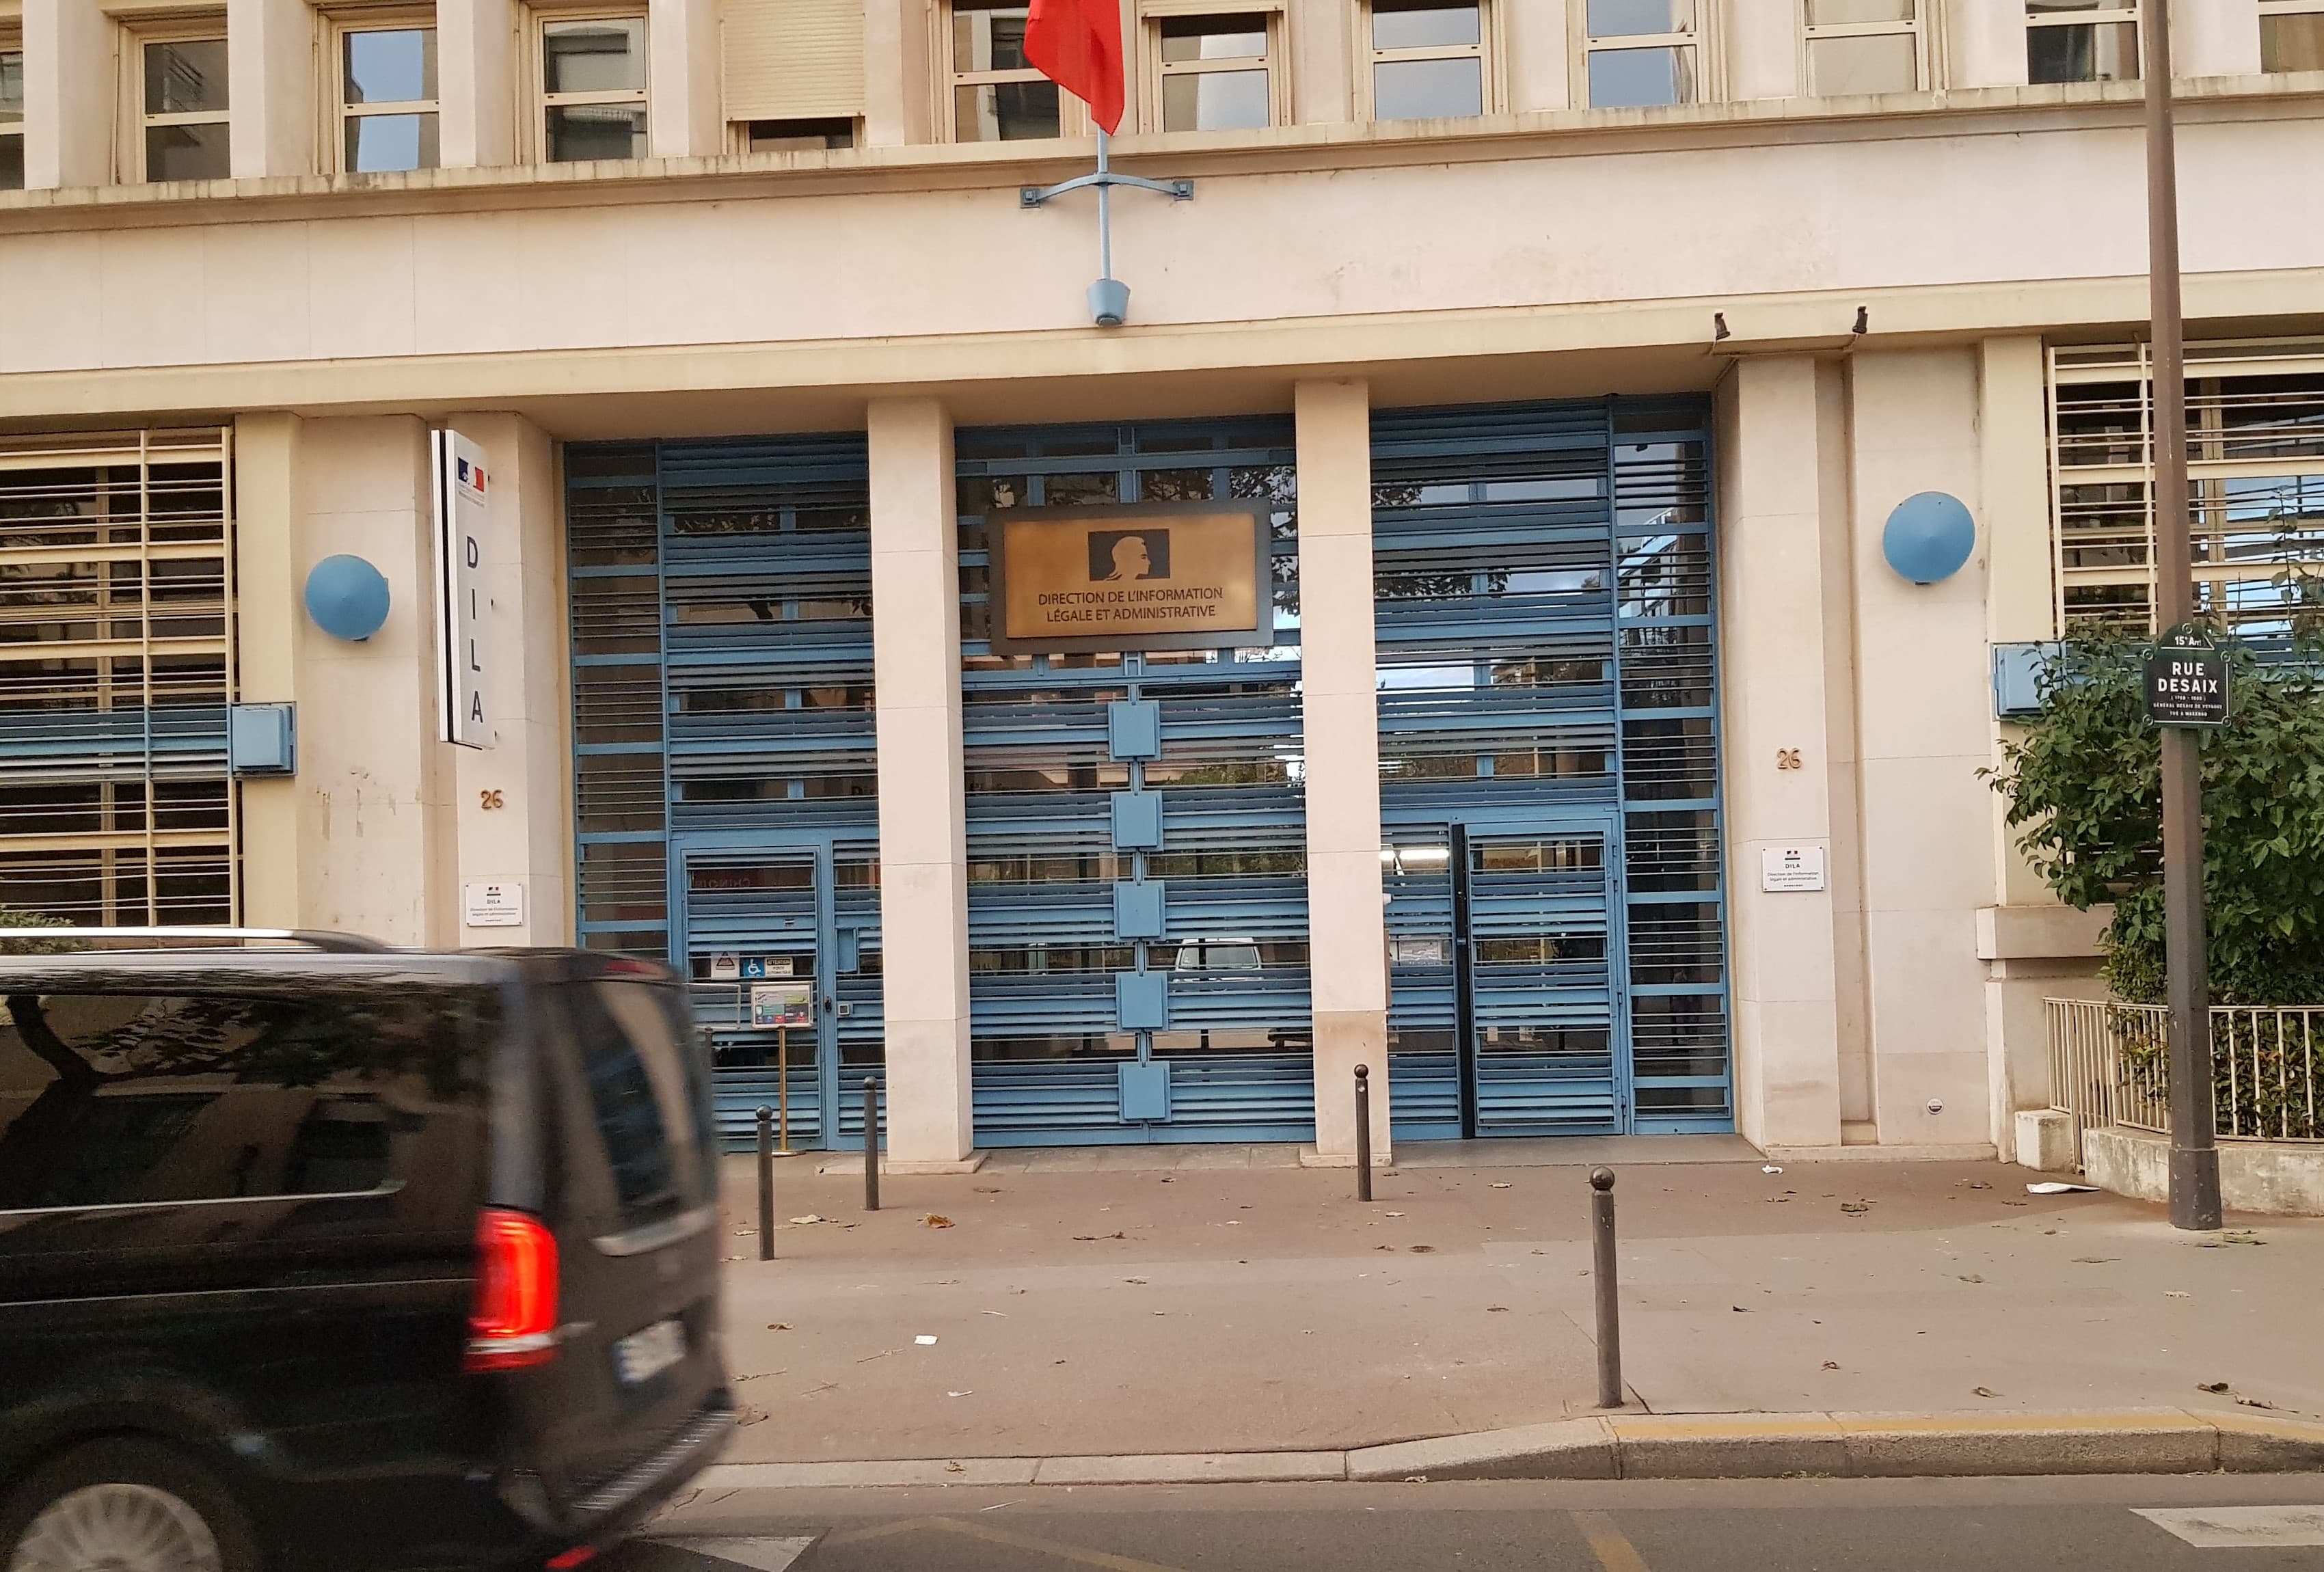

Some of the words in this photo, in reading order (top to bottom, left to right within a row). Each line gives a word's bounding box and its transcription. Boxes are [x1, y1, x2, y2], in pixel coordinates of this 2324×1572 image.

[1038, 592, 1105, 606] DIRECTION
[1108, 591, 1124, 603] DE
[1128, 587, 1223, 602] L'INFORMATION
[1046, 608, 1093, 622] LÉGALE
[1096, 609, 1111, 621] ET
[1113, 605, 1216, 620] ADMINISTRATIVE
[466, 536, 483, 723] DILA
[2172, 662, 2205, 676] RUE
[2158, 678, 2217, 694] DESAIX
[1777, 748, 1802, 770] 26
[480, 789, 504, 809] 26
